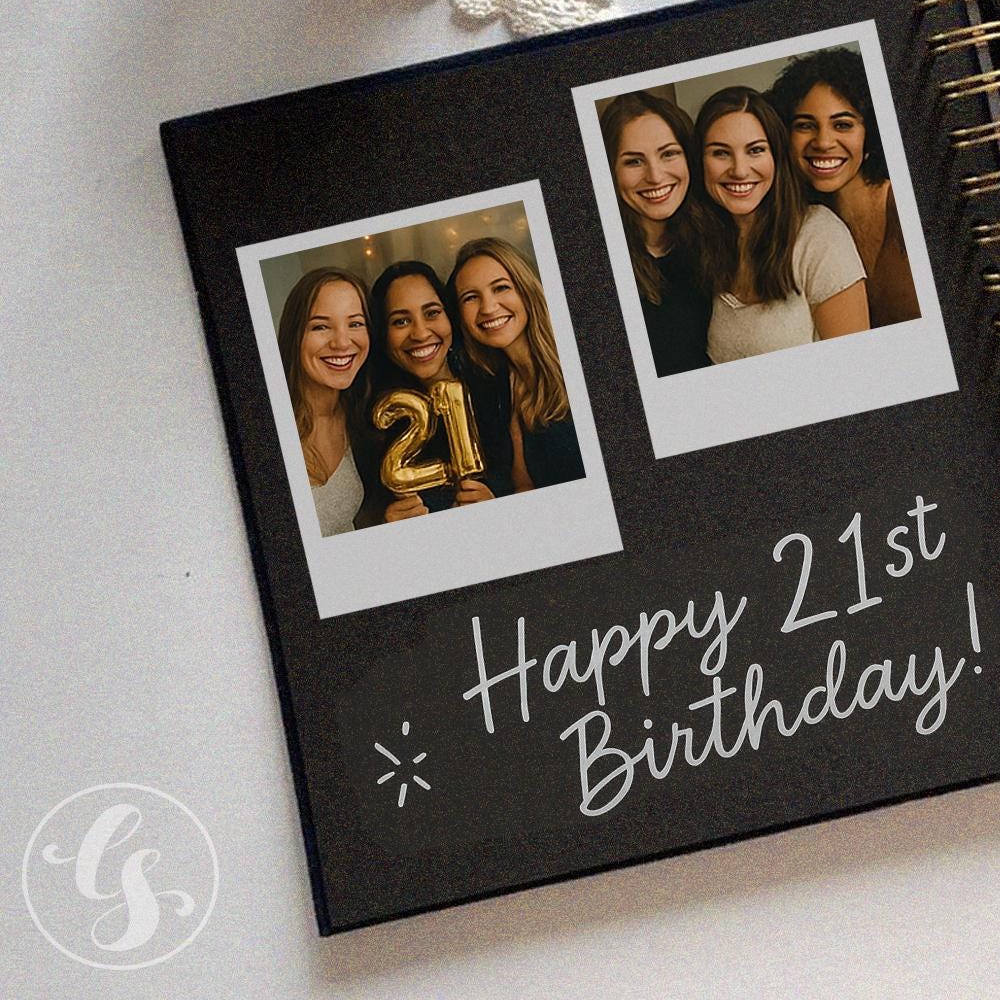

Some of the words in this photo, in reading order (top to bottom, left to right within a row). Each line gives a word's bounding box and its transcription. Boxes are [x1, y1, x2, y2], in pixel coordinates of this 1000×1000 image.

[372, 379, 485, 493] 21
[463, 590, 748, 734] Happy
[772, 494, 946, 634] 21st
[559, 581, 983, 816] Birthday!
